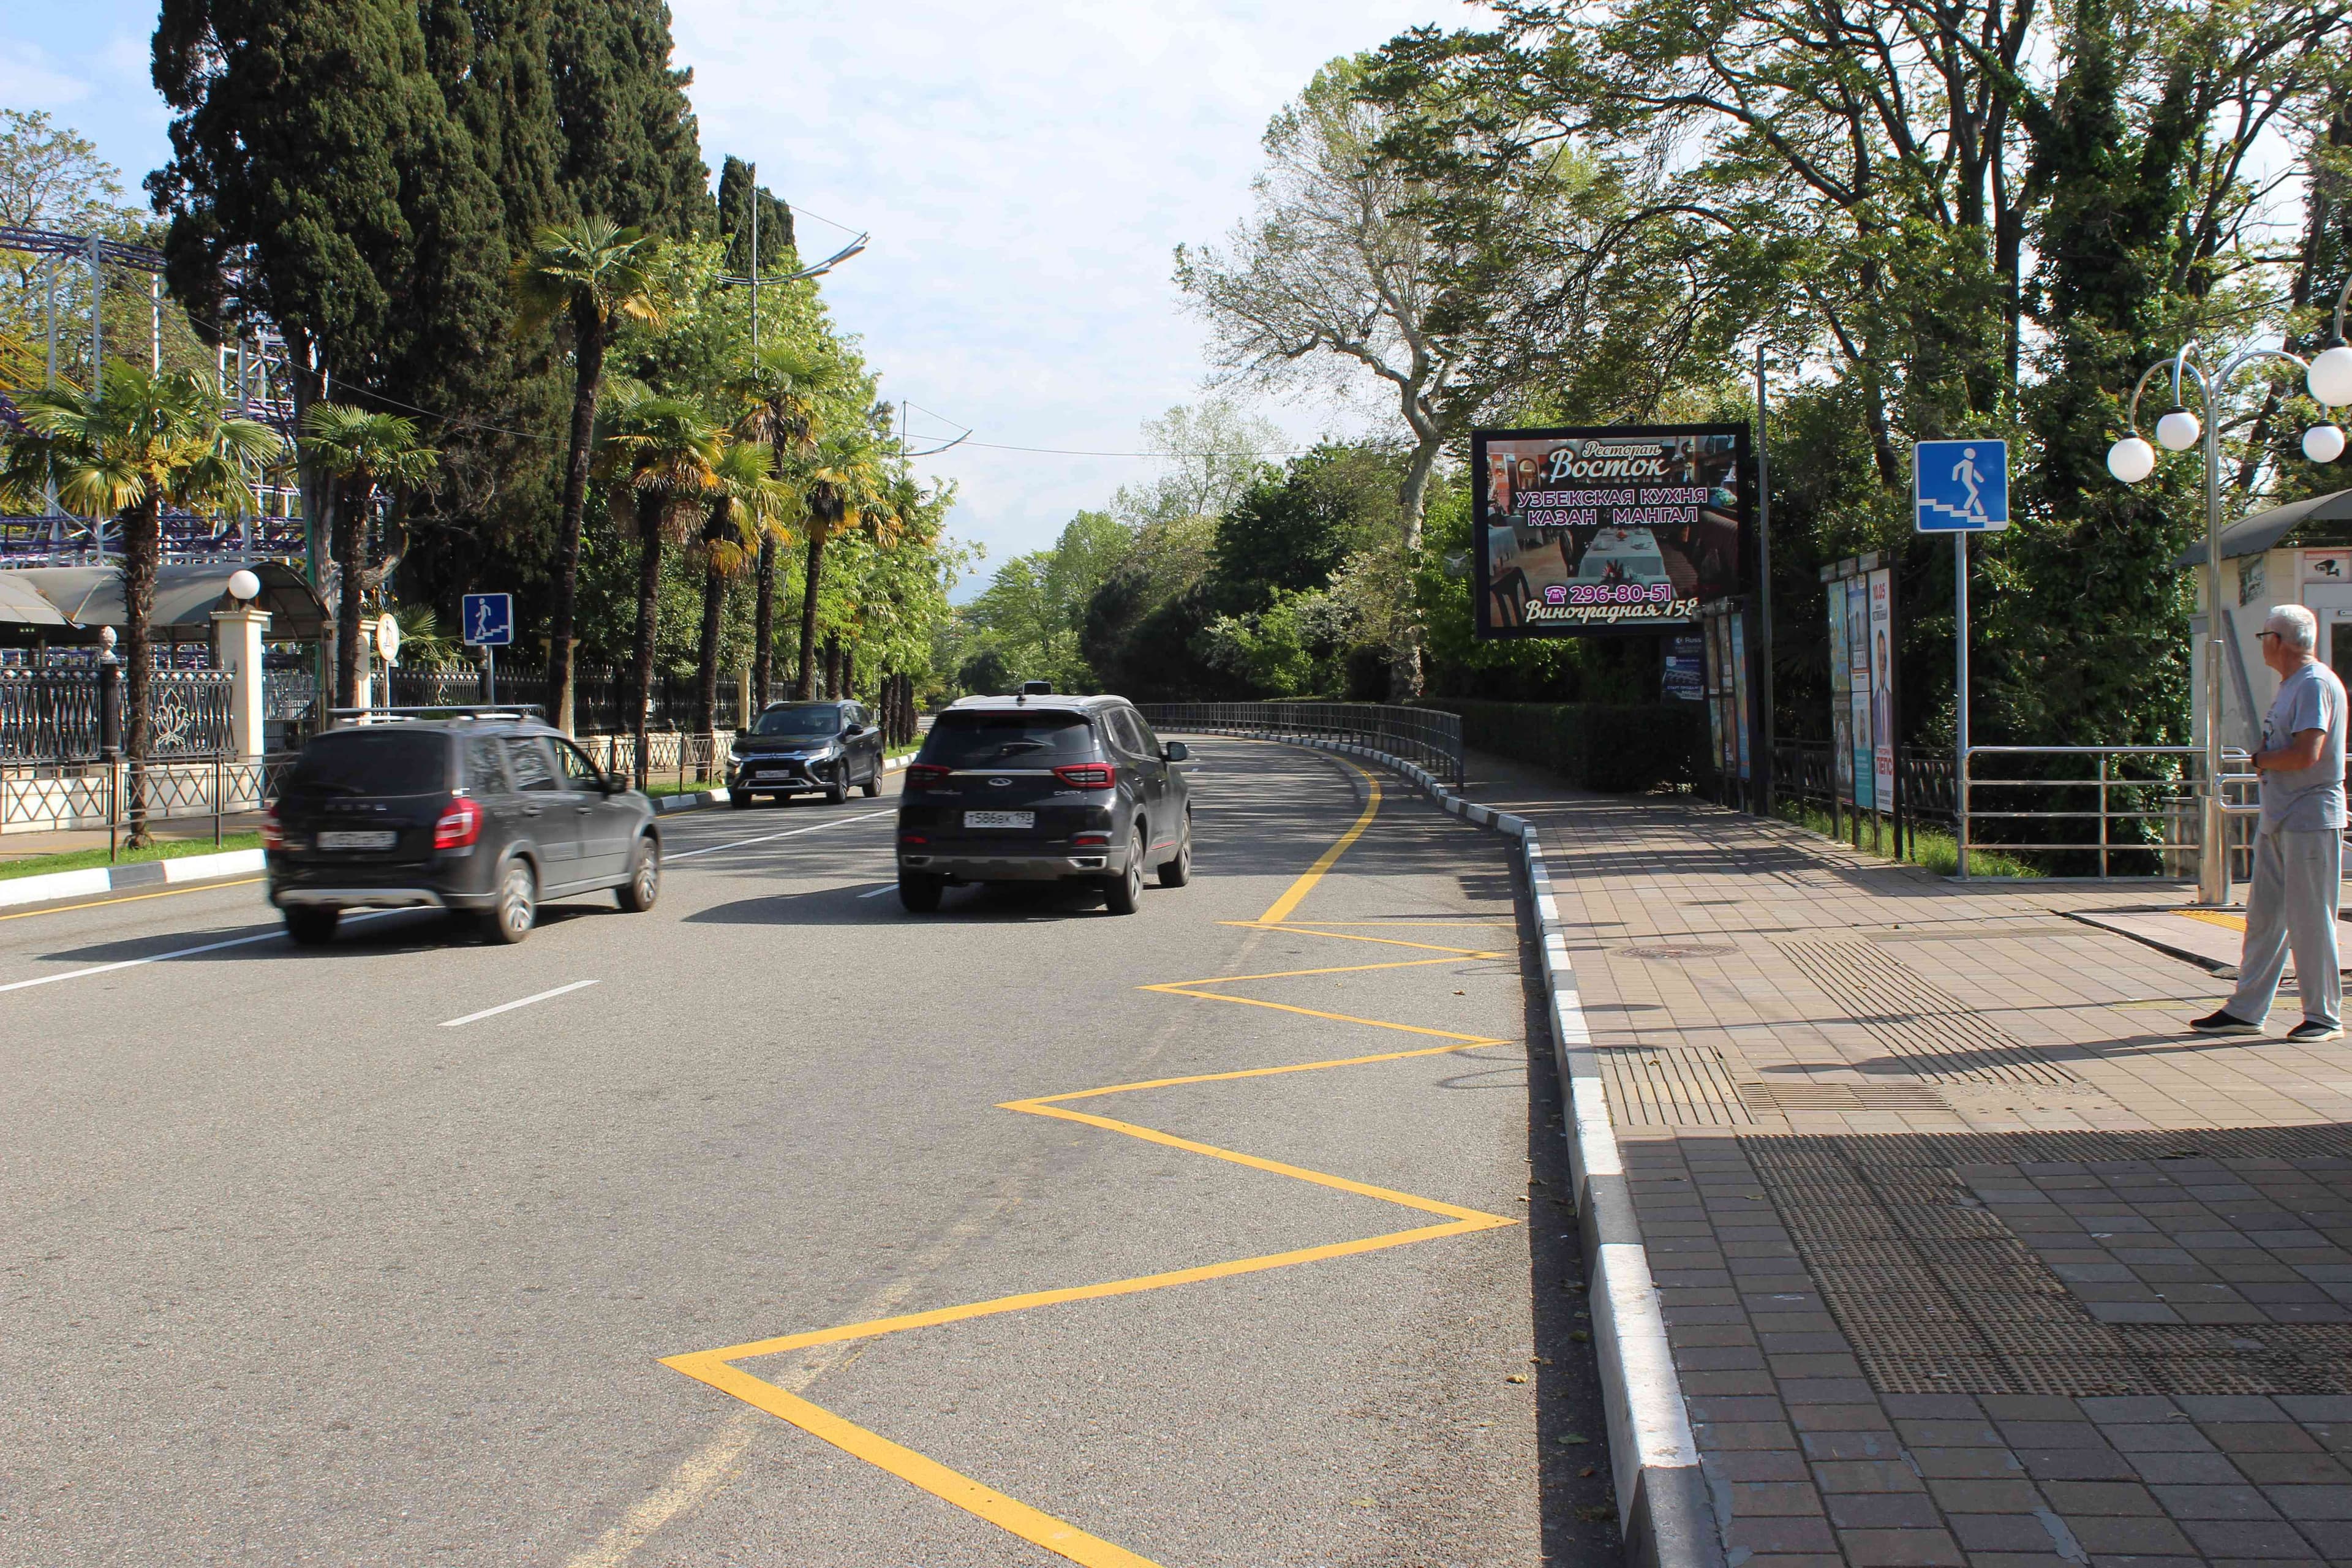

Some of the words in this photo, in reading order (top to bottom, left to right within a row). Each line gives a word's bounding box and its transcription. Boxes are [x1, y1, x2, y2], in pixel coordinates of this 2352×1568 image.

[1581, 440, 1662, 461] Ресторан
[1550, 448, 1670, 483] Восток
[1515, 489, 1635, 508] УЗБЕКСКАЯ
[1640, 487, 1708, 505] КУХНЯ
[1528, 508, 1597, 526] КАЗАН
[1613, 506, 1698, 524] МАНГАЛ
[1569, 584, 1671, 603] 296-80-51
[1525, 599, 1662, 624] Виноградная
[1663, 597, 1698, 617] 158
